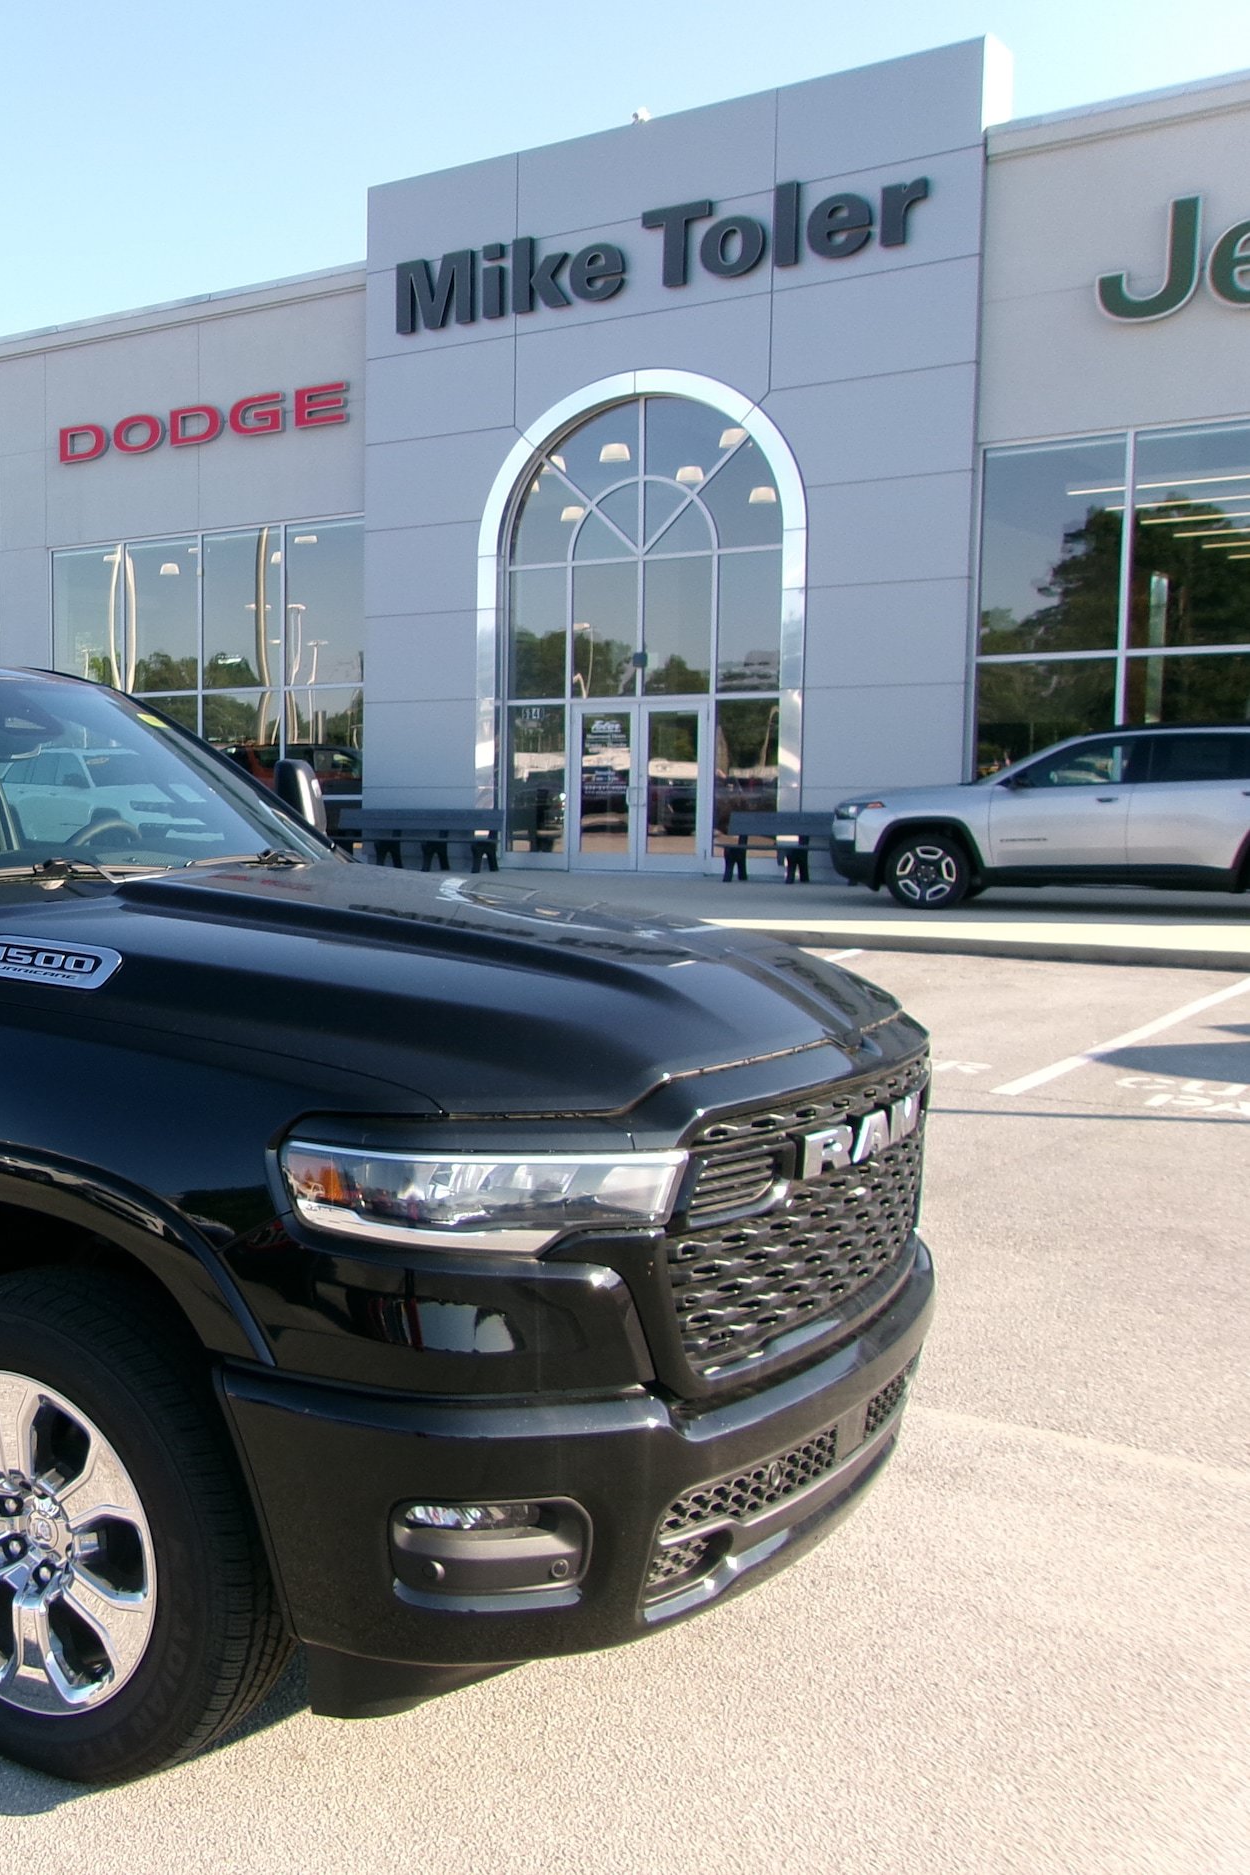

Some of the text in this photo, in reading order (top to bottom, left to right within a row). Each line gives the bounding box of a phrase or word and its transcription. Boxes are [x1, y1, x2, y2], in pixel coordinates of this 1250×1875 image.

[395, 176, 929, 335] Mike Toler
[59, 380, 349, 465] DODGE
[801, 1090, 921, 1181] RAM
